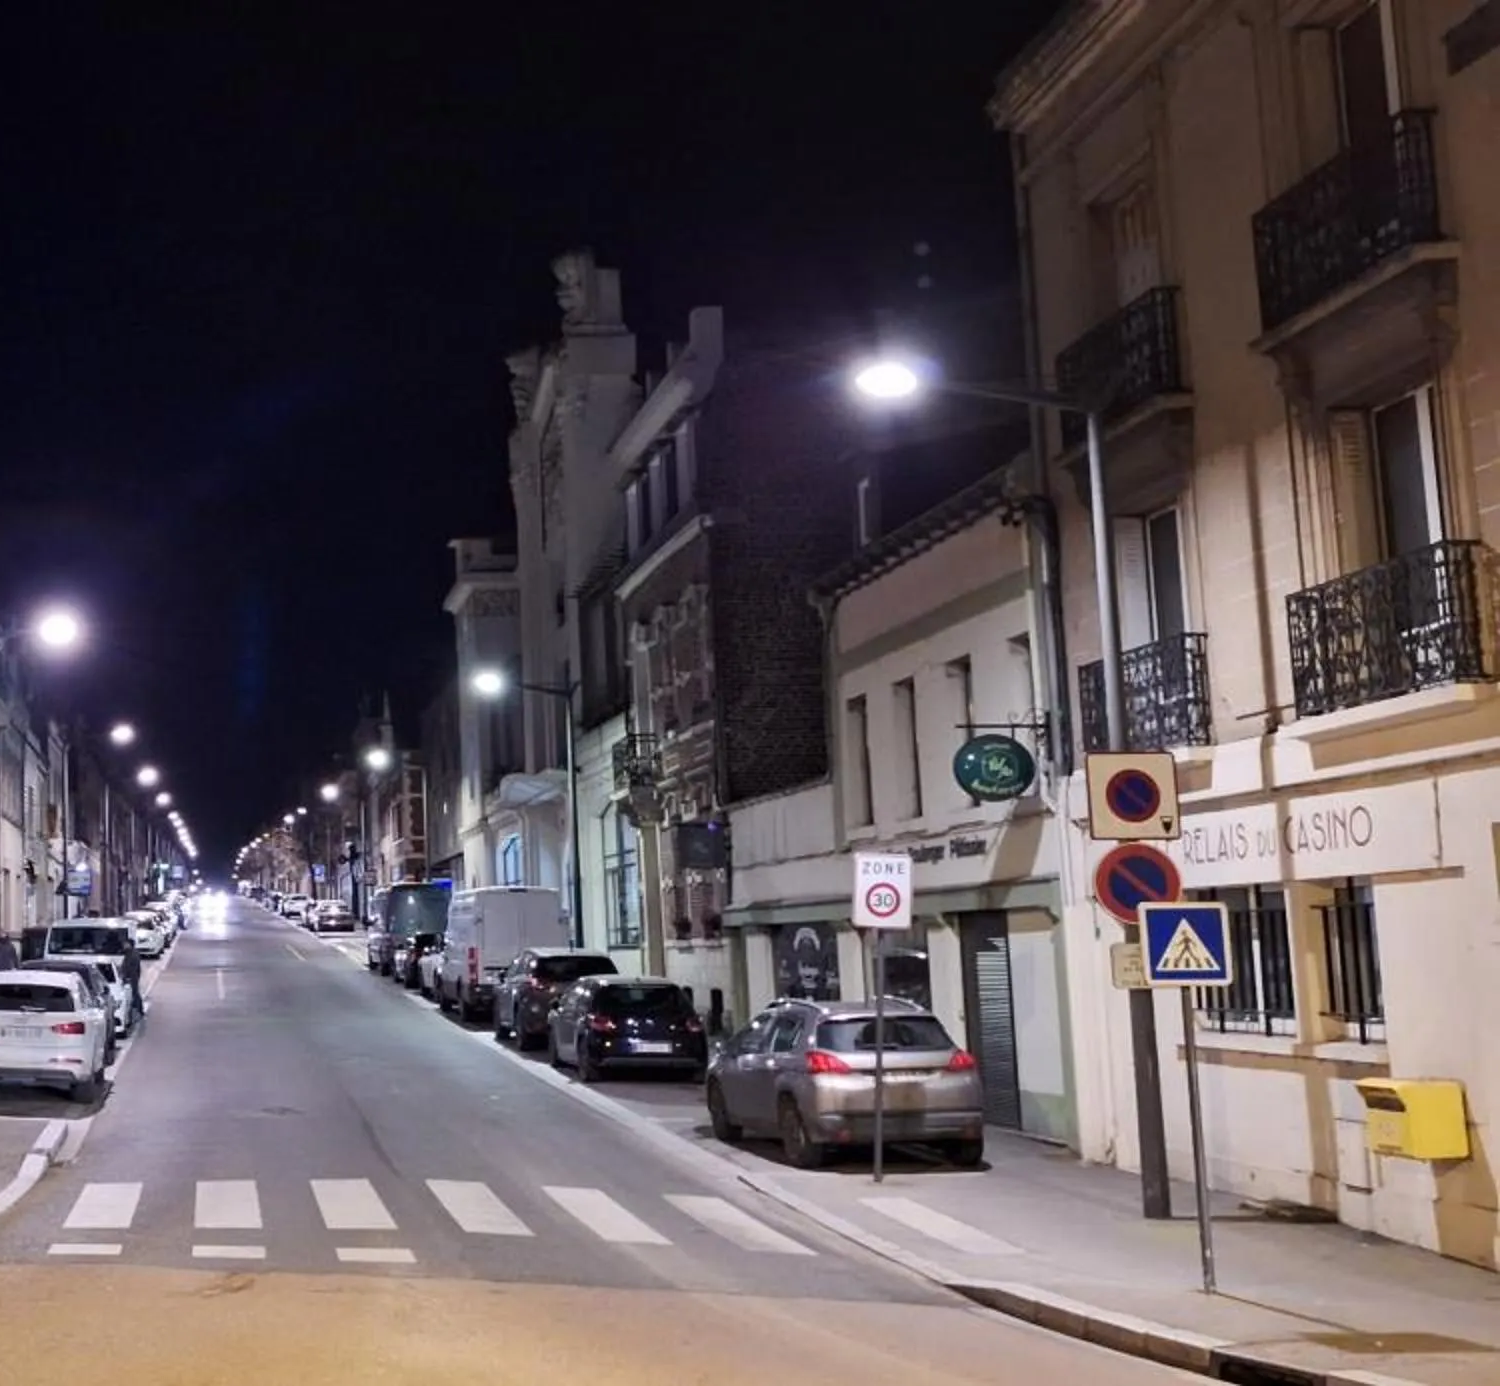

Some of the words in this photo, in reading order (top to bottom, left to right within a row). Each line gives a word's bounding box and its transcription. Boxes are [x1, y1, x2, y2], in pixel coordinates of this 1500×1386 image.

[1182, 822, 1249, 866] RELAIS
[1257, 829, 1276, 859] DU
[1283, 805, 1373, 855] CASINO
[861, 862, 905, 875] ZONE
[873, 892, 894, 908] 30
